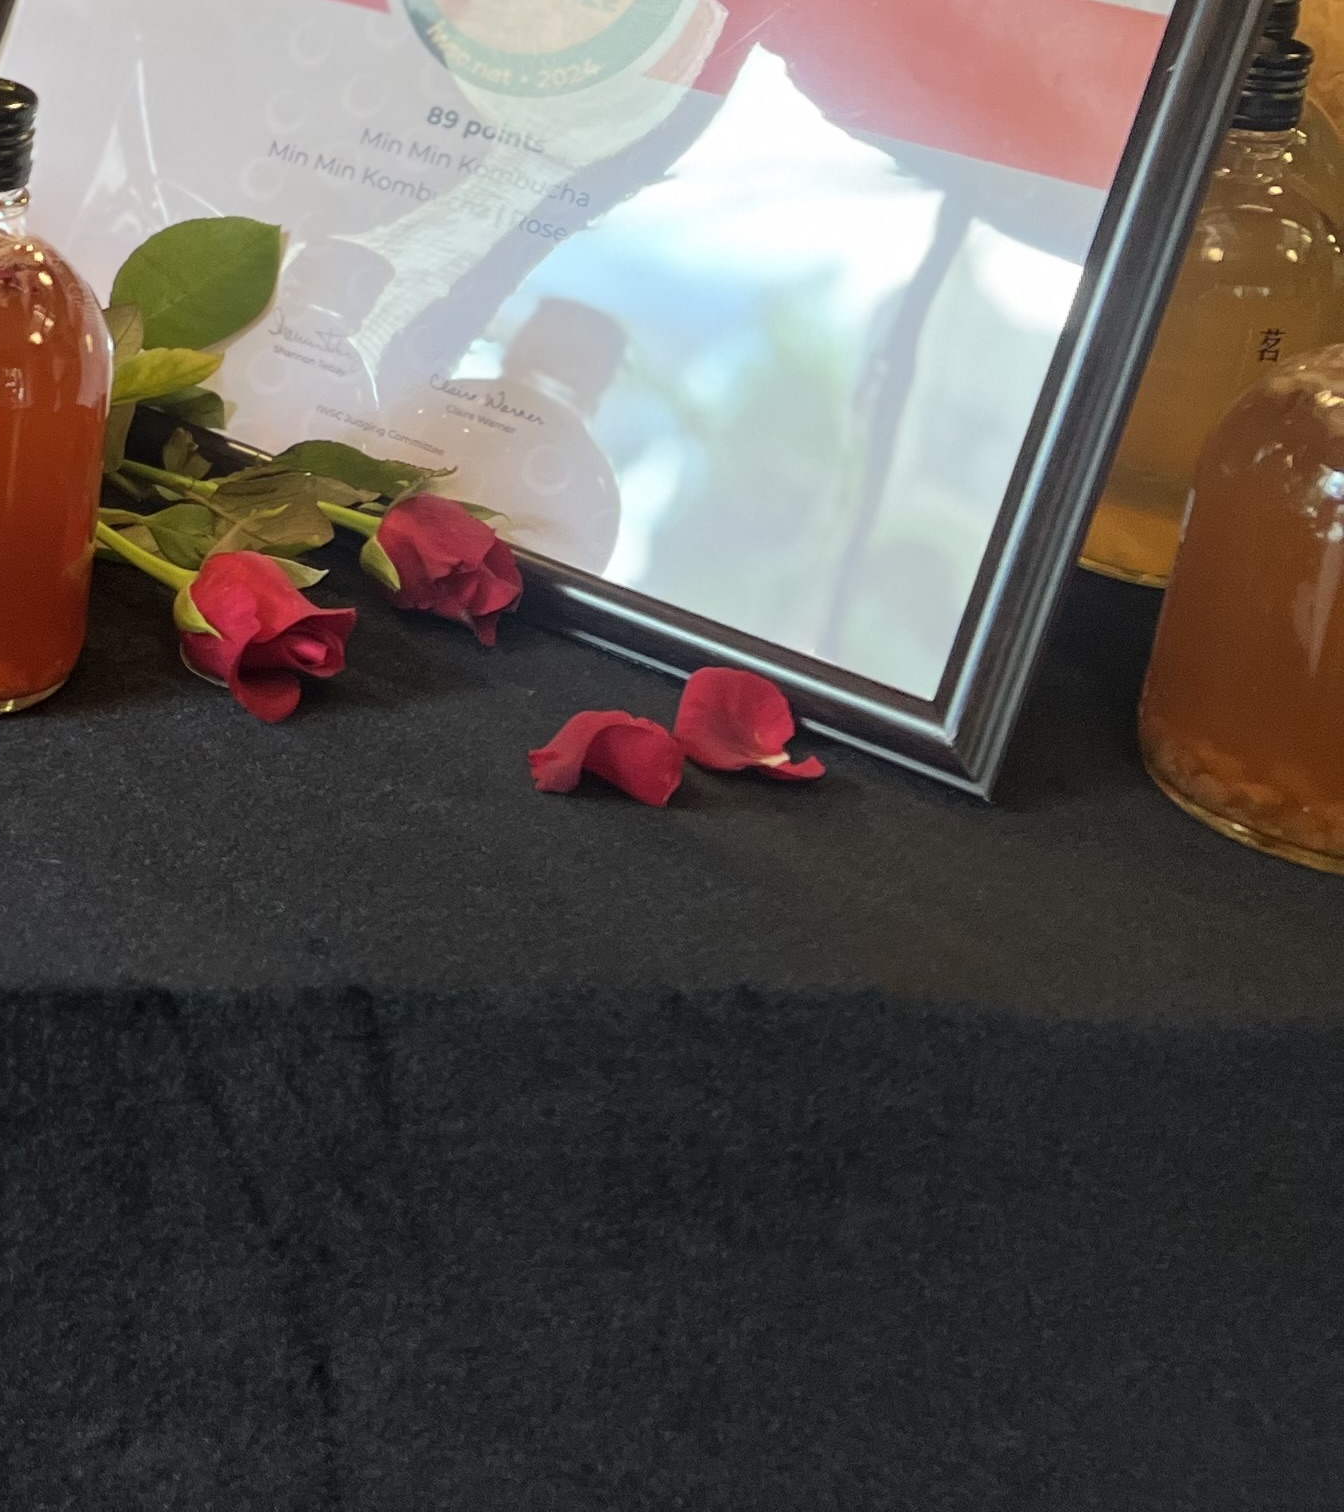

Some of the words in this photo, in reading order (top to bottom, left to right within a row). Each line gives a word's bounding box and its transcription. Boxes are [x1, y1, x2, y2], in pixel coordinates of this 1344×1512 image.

[537, 58, 601, 89] 2024
[425, 105, 460, 130] 89
[462, 119, 546, 154] points
[267, 140, 309, 168] Min
[314, 152, 357, 182] Min
[360, 128, 402, 155] Min
[407, 141, 452, 170] Min
[458, 154, 591, 208] Kombucha
[272, 344, 316, 365] Shannon
[1257, 328, 1286, 362] 茗
[388, 427, 445, 457] Committee
